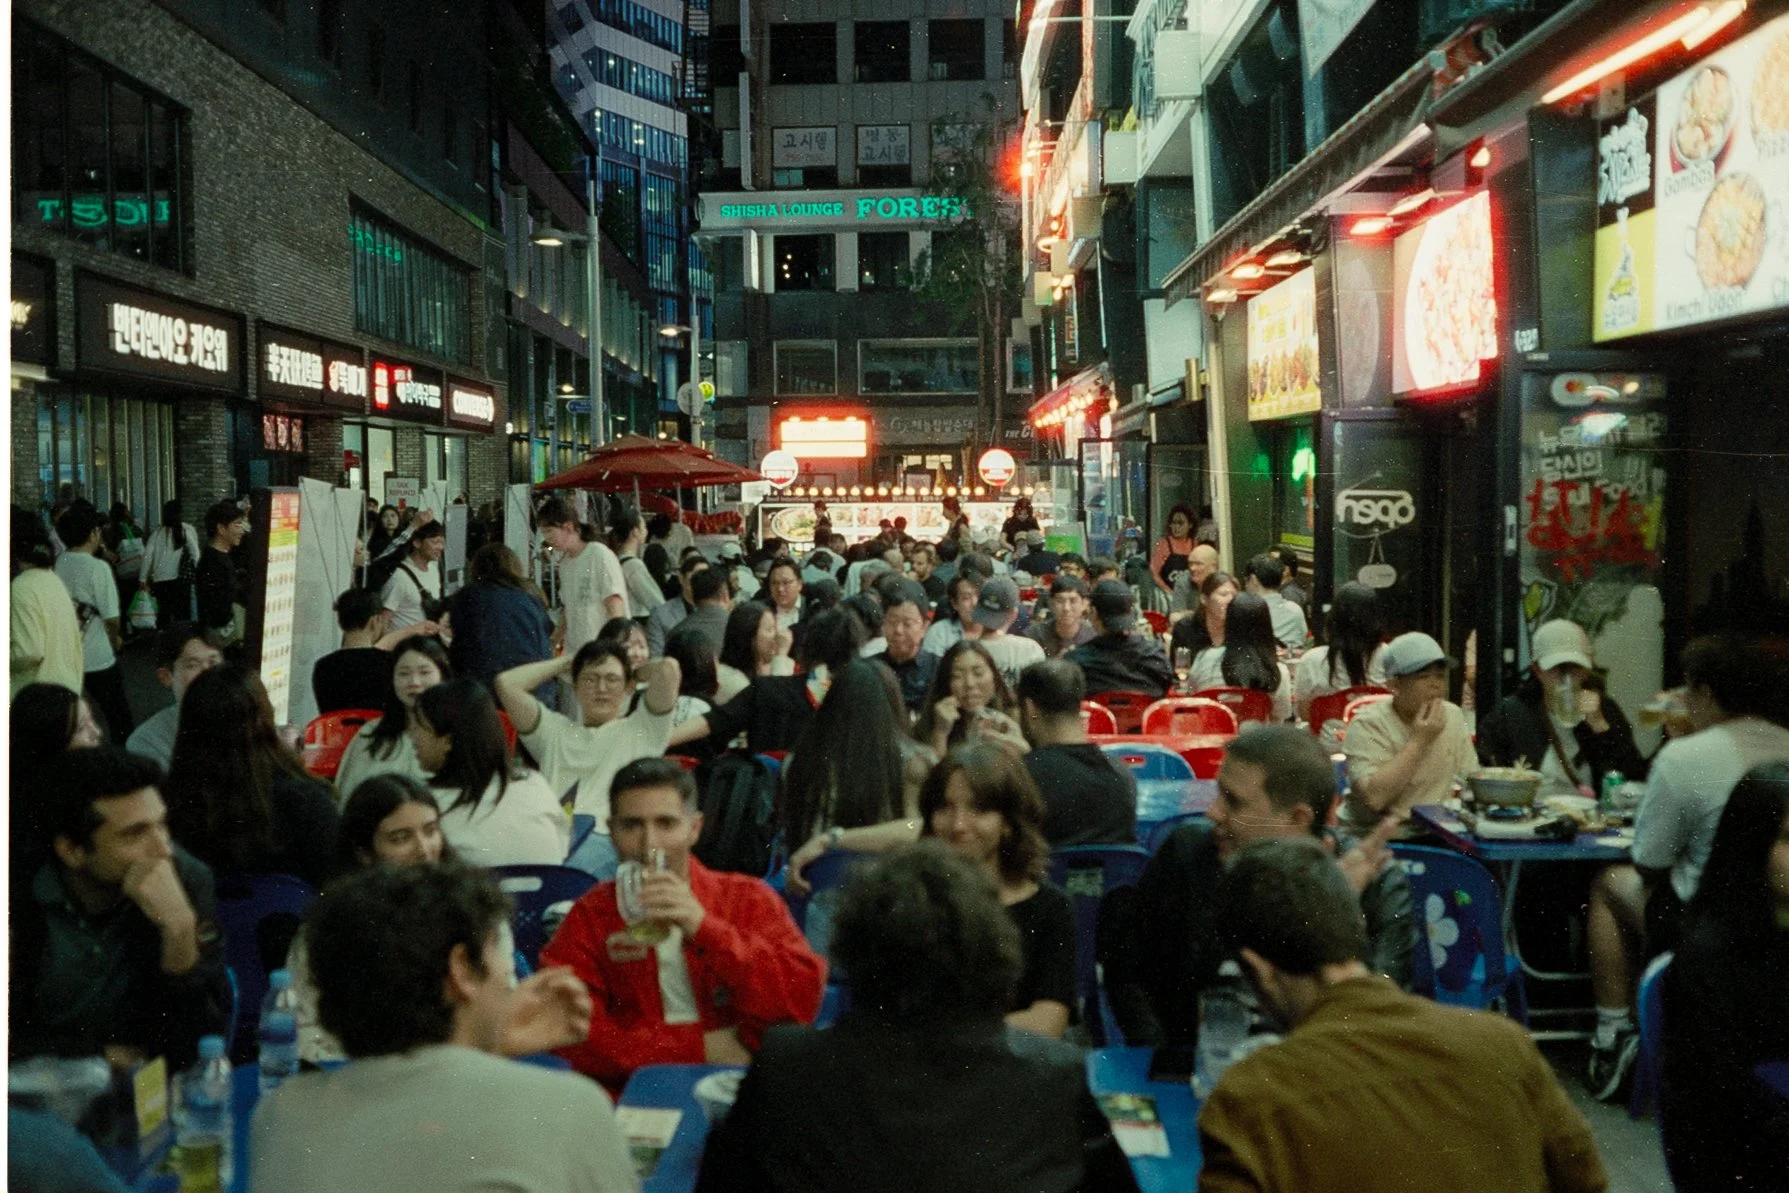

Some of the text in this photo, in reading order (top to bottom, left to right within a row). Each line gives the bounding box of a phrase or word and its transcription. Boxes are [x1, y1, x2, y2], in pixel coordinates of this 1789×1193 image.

[720, 196, 974, 220] SHISHA LOUNGE FORES
